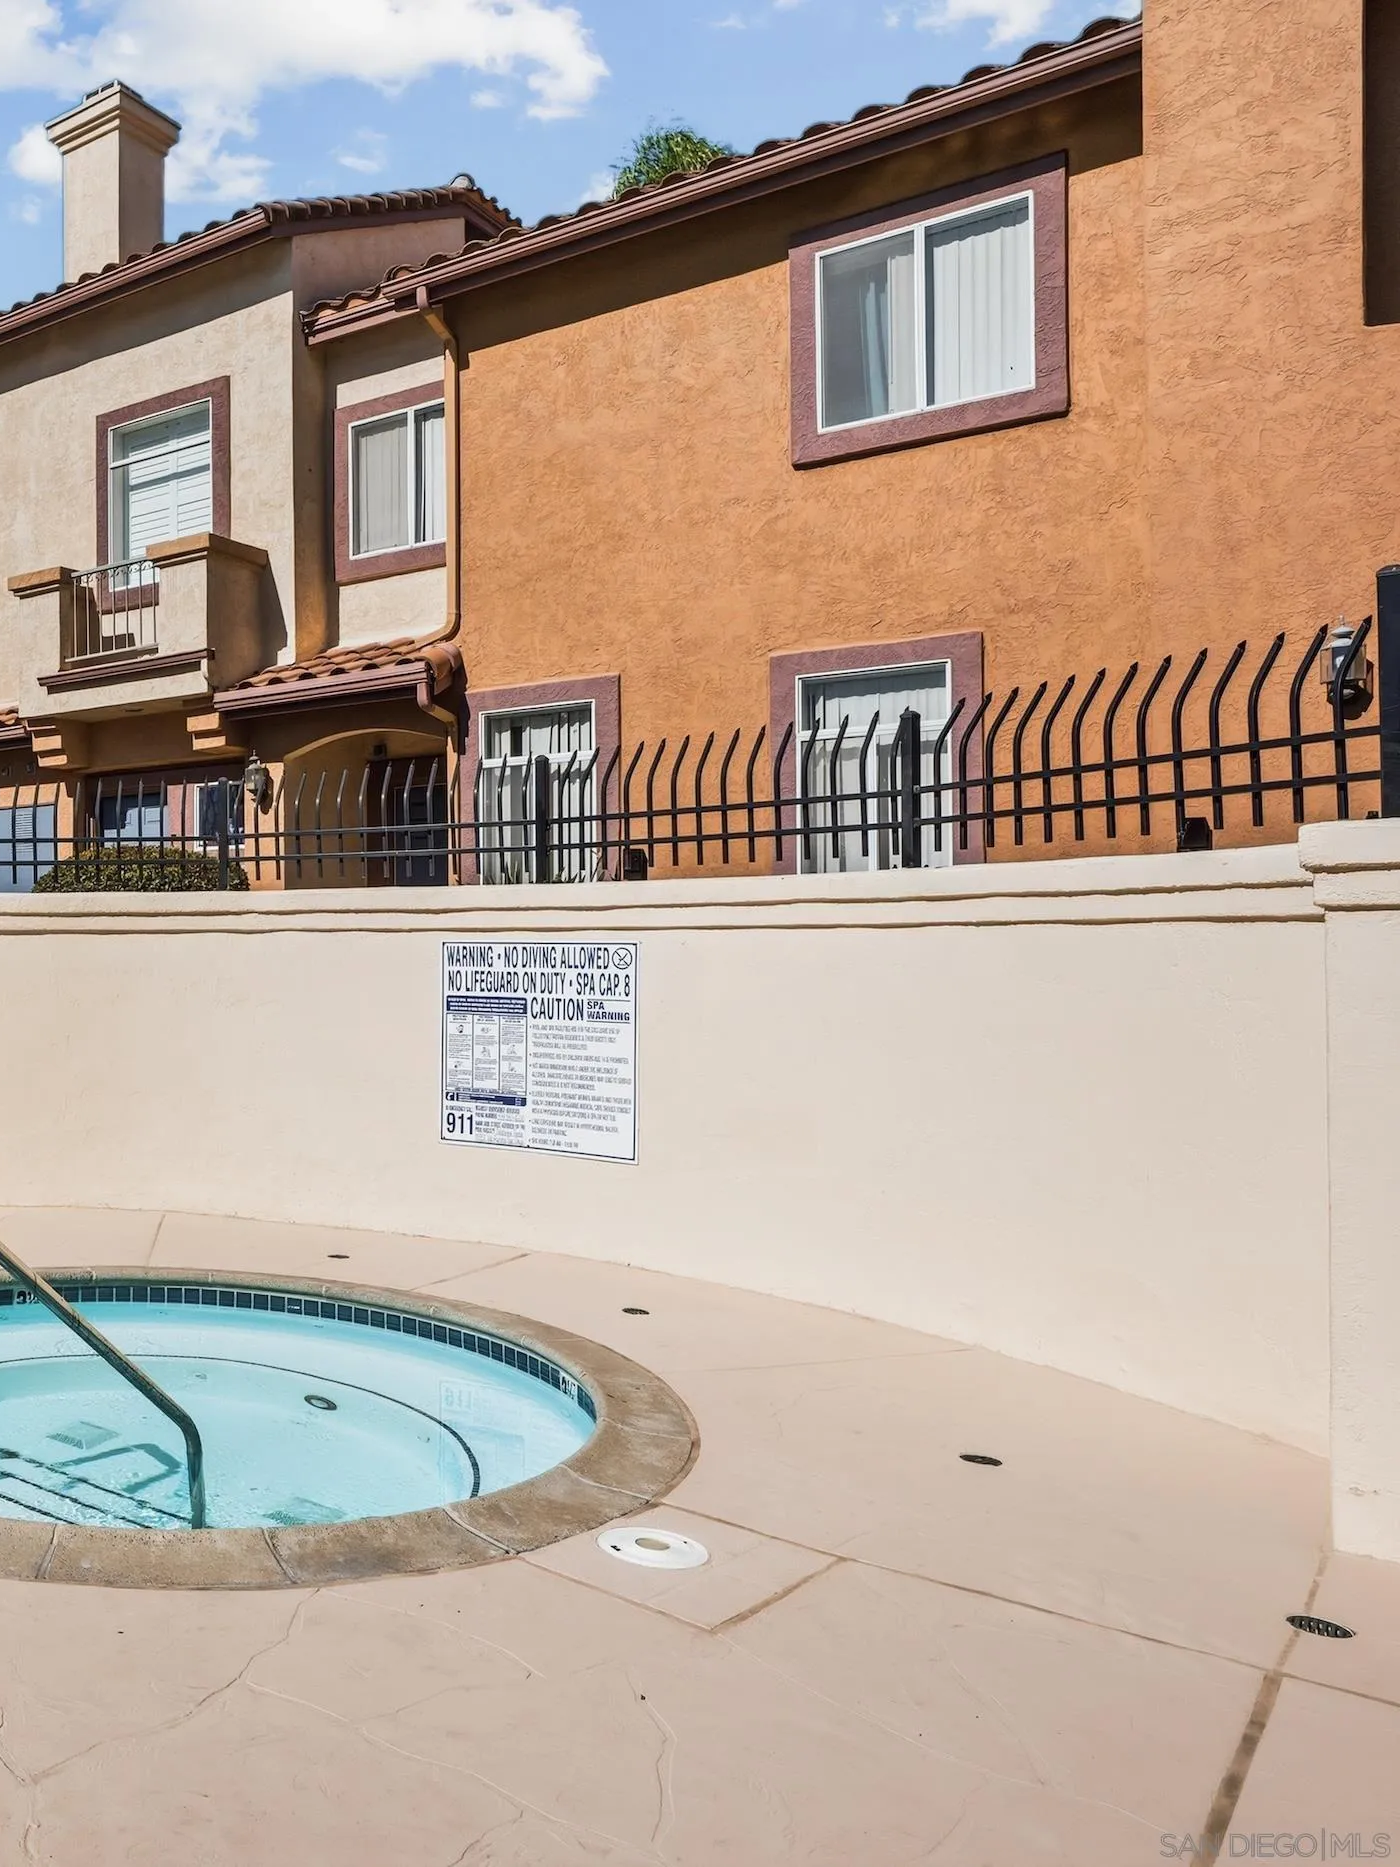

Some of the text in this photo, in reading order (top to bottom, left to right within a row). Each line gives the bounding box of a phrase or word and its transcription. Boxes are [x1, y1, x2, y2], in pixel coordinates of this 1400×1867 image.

[446, 945, 610, 969] WARNING NO DIVING ALLOWED
[448, 970, 631, 997] NO LIFEGUARD ON DUTY SPA CAP. 8
[530, 997, 584, 1021] CAUTION
[587, 1001, 605, 1010] SPA
[587, 1011, 630, 1021] WARNING
[446, 1112, 473, 1135] 911
